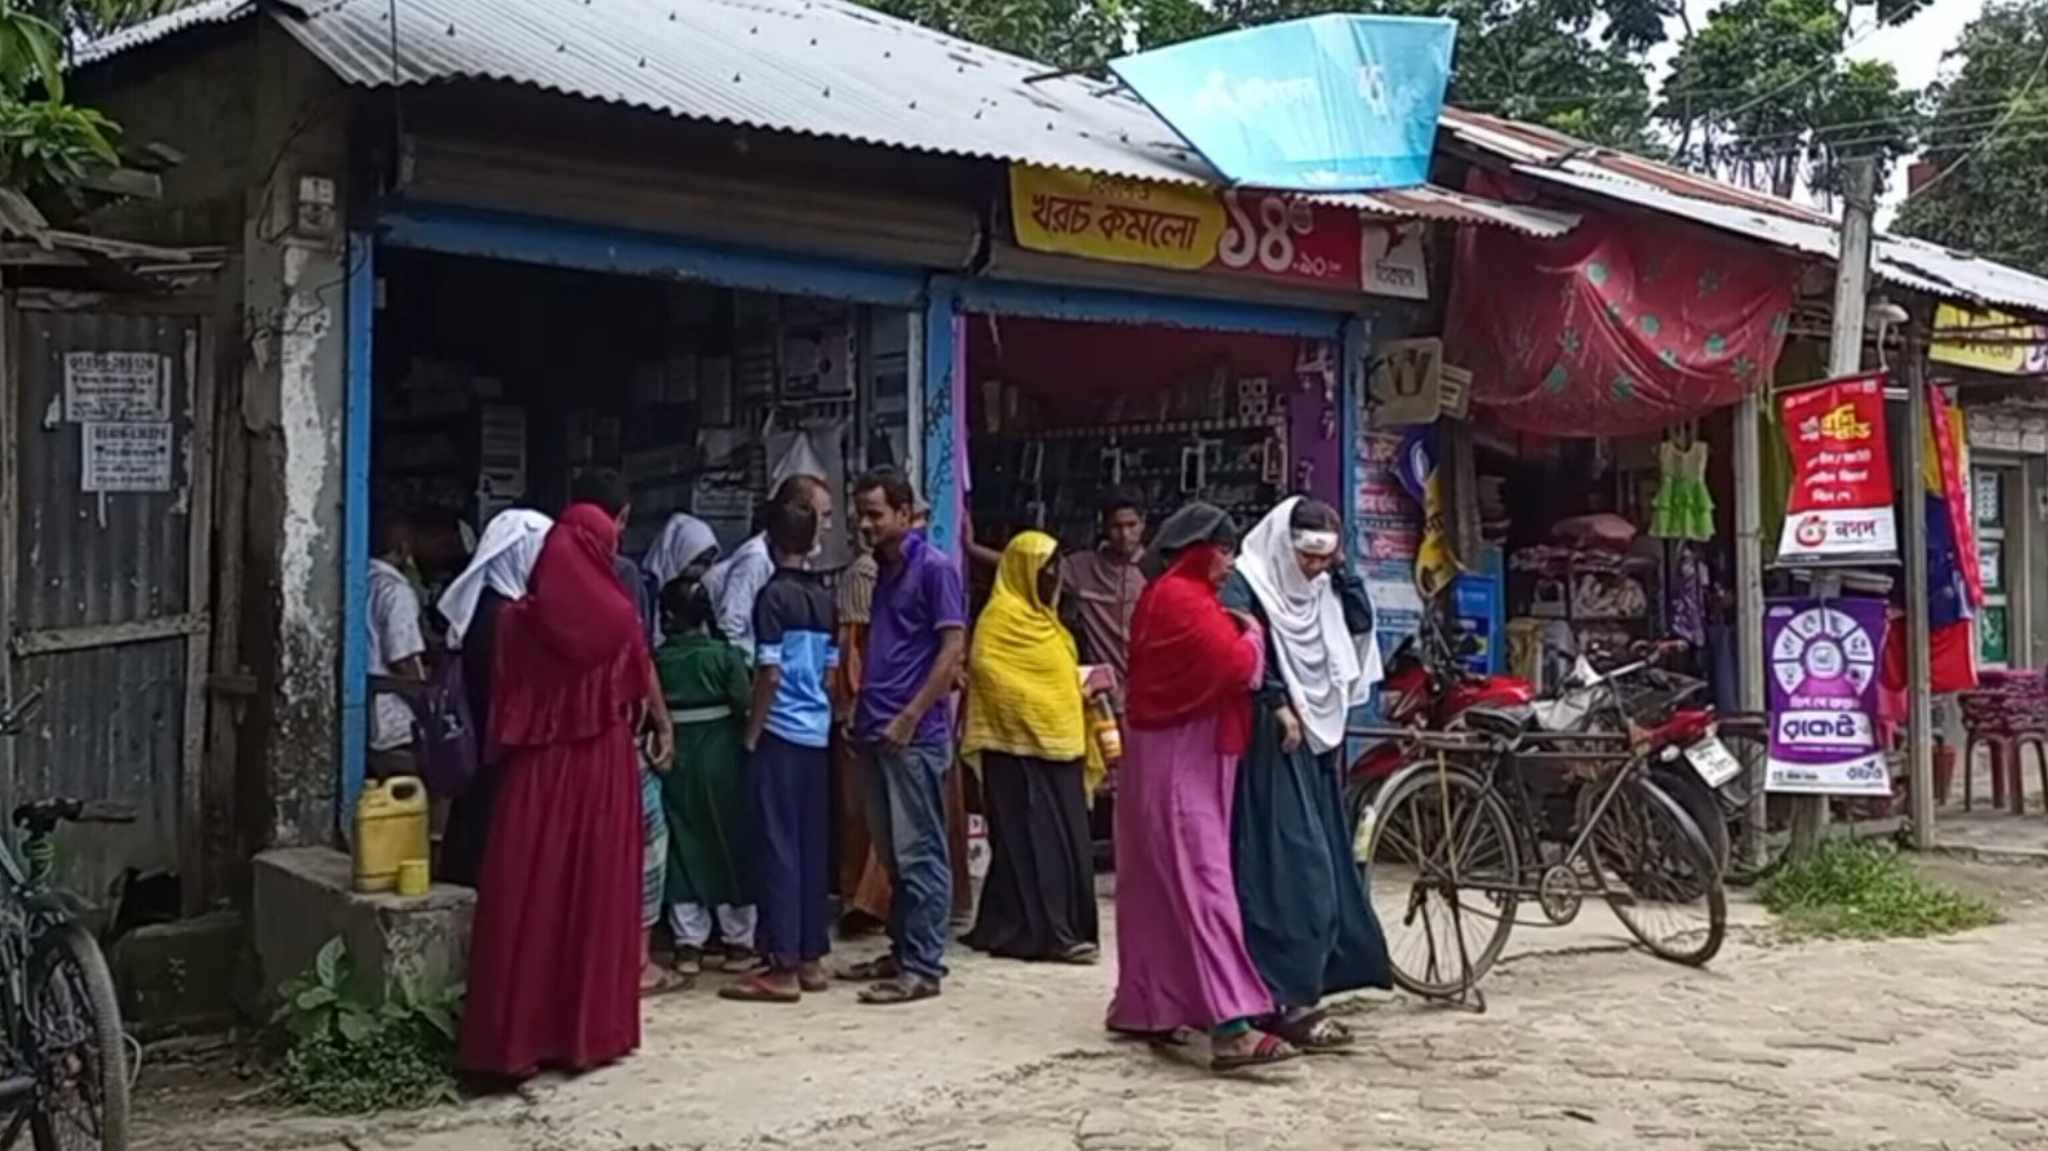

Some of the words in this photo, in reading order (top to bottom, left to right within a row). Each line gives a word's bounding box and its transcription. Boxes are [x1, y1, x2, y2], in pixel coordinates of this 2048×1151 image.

[1031, 194, 1093, 235] খরচ
[1098, 204, 1200, 252] কমলো
[1833, 519, 1878, 538] নগদ
[1783, 713, 1856, 740] রকেট
